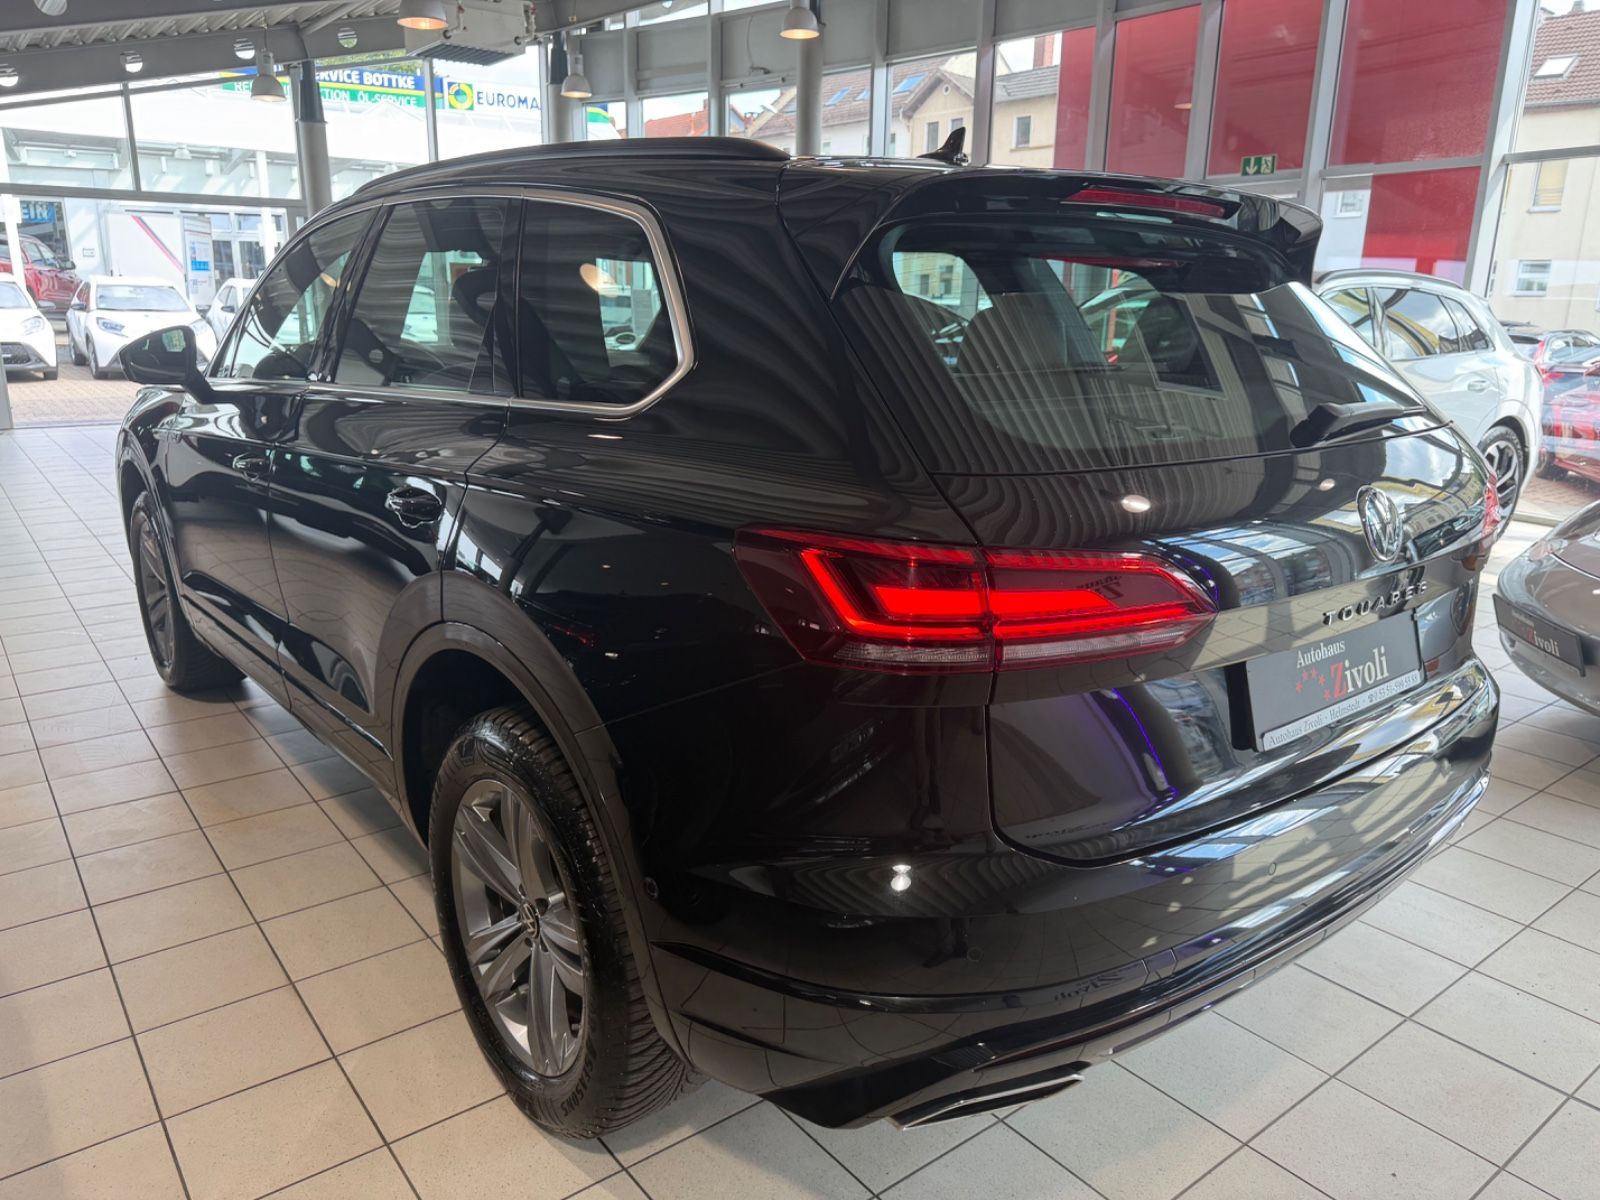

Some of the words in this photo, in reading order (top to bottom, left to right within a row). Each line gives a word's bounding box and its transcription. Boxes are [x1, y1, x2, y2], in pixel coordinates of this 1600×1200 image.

[363, 71, 416, 90] BOTTKE
[476, 91, 542, 110] EUROMA
[1323, 580, 1428, 627] TOUAREG
[1296, 640, 1346, 669] Autohaus
[1330, 645, 1390, 698] Zivoli
